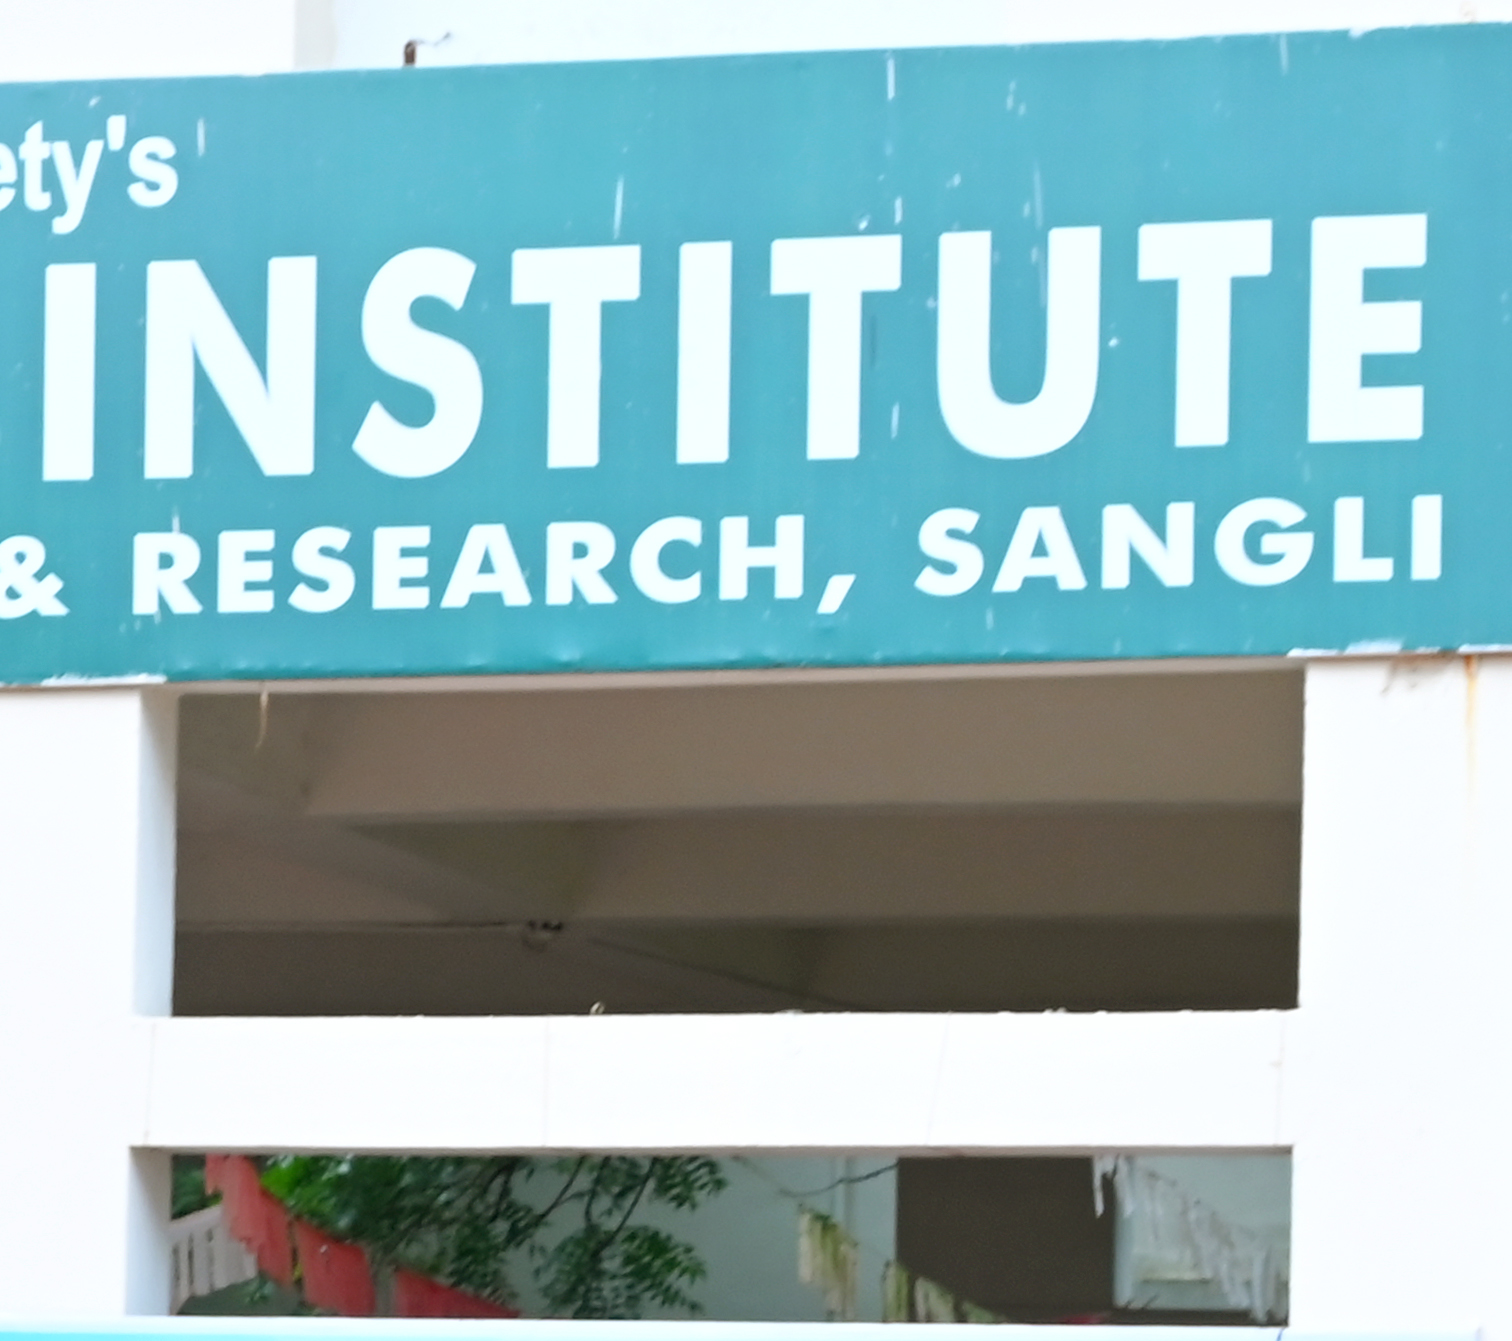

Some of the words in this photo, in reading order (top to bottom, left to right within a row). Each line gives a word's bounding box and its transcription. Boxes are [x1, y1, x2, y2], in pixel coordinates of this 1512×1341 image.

[41, 213, 1428, 485] INSTITUTE
[133, 515, 855, 615] RESEARCH,
[915, 495, 1442, 596] SANGLI
